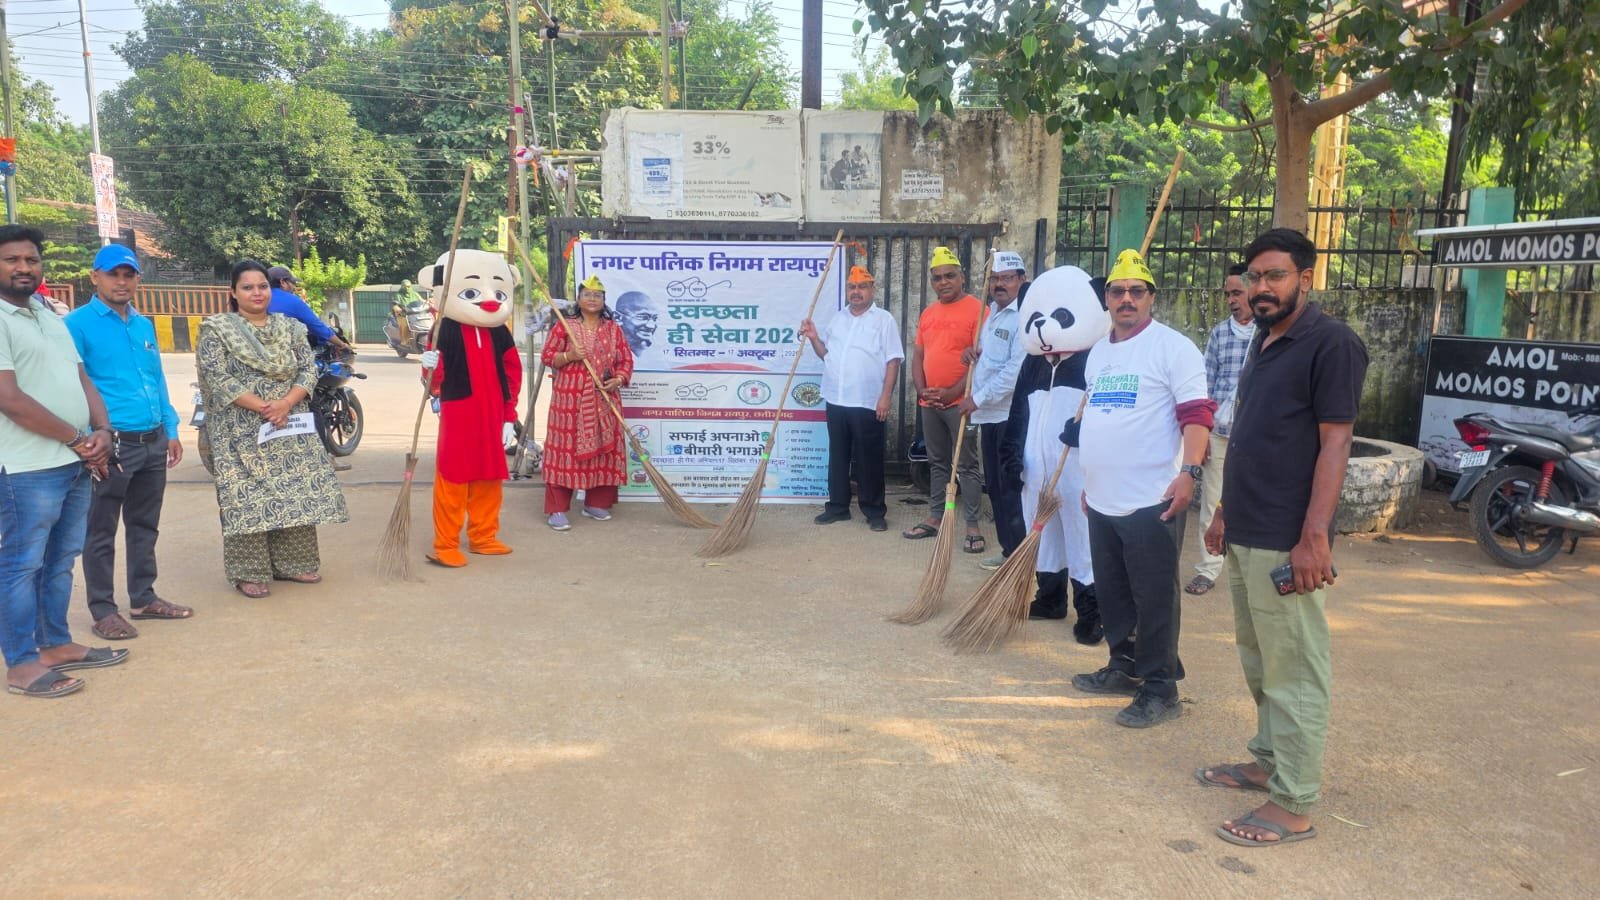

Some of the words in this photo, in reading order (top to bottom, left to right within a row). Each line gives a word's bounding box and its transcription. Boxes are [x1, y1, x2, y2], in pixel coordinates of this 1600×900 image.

[693, 141, 730, 154] 33%
[1445, 238, 1493, 262] AMOL
[1500, 234, 1576, 261] MOMOS
[591, 256, 637, 271] नगर
[640, 251, 704, 271] पालिक
[709, 252, 765, 272] निगम
[667, 304, 758, 320] स्वच्छता
[667, 323, 694, 345] ही
[702, 324, 751, 344] सेवा
[674, 347, 716, 358] सितम्बर
[737, 350, 777, 361] अक्टूबर
[1486, 345, 1559, 371] AMOL
[1435, 371, 1526, 399] MOMOS
[1534, 379, 1600, 406] POIN
[669, 429, 707, 442] सफाई
[710, 430, 760, 442] अपनाओ
[684, 443, 723, 456] बीमारी
[725, 444, 765, 457] भगाओ
